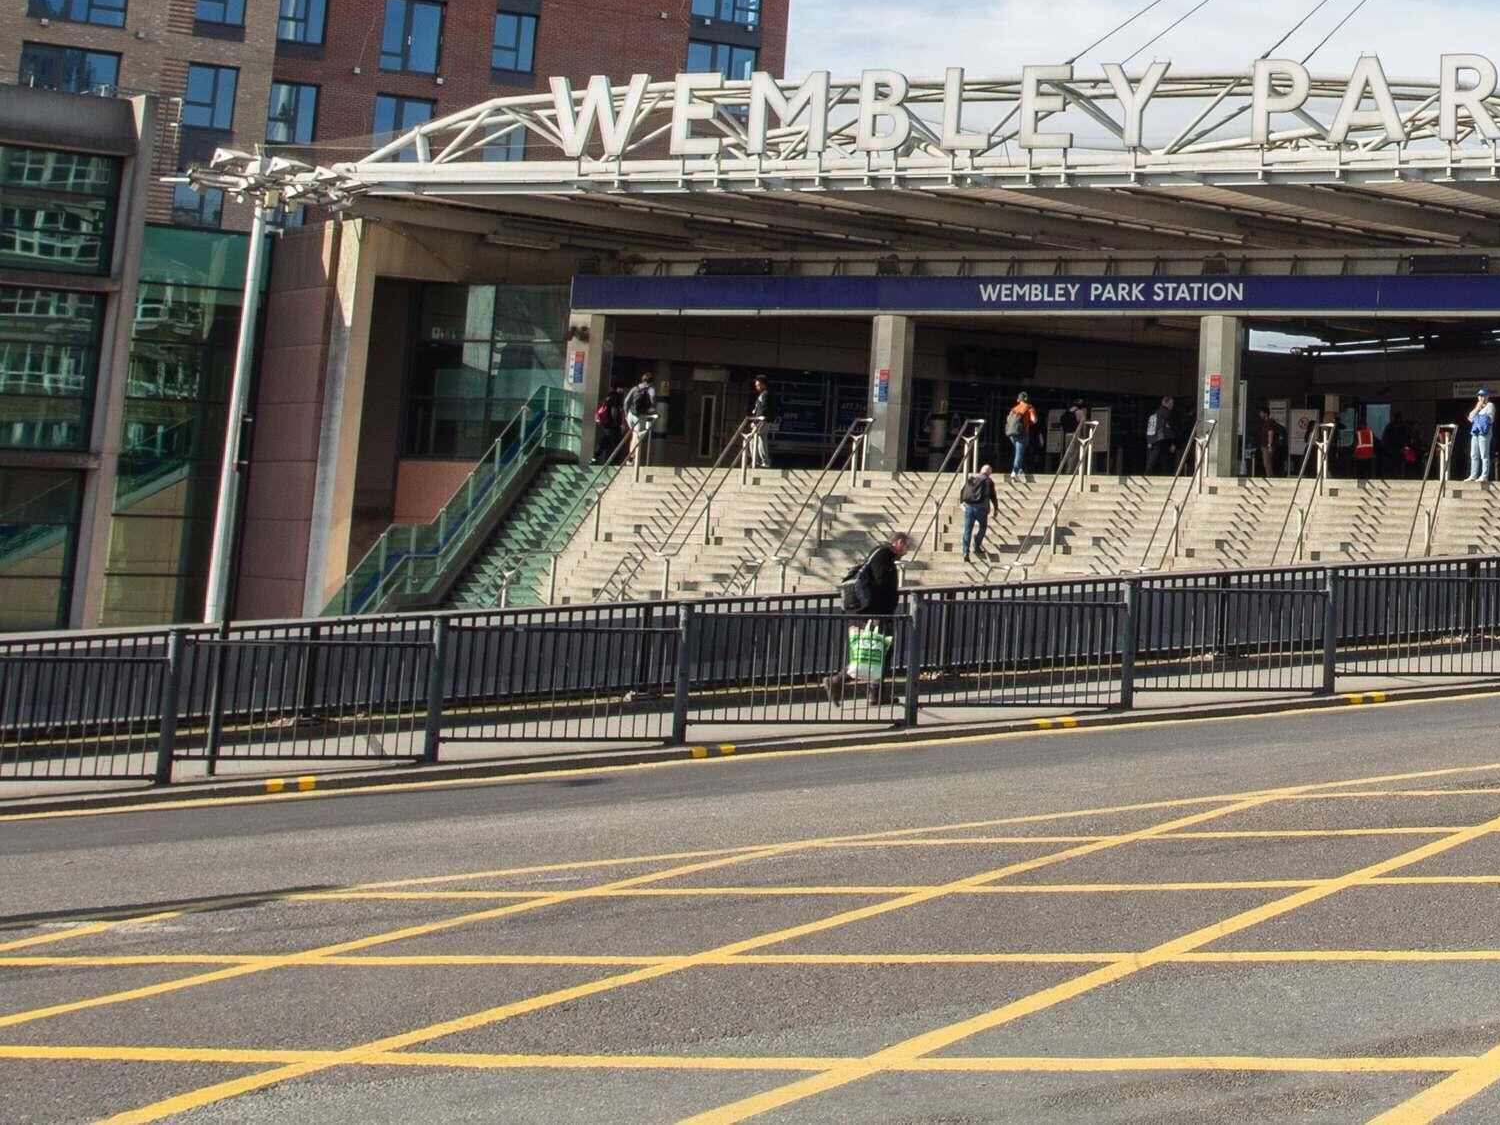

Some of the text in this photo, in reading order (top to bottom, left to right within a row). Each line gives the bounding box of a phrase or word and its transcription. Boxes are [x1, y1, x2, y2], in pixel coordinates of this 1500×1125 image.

[550, 62, 1171, 157] WEMBLEY
[979, 283, 1244, 301] WEMBLEY PARK STATION
